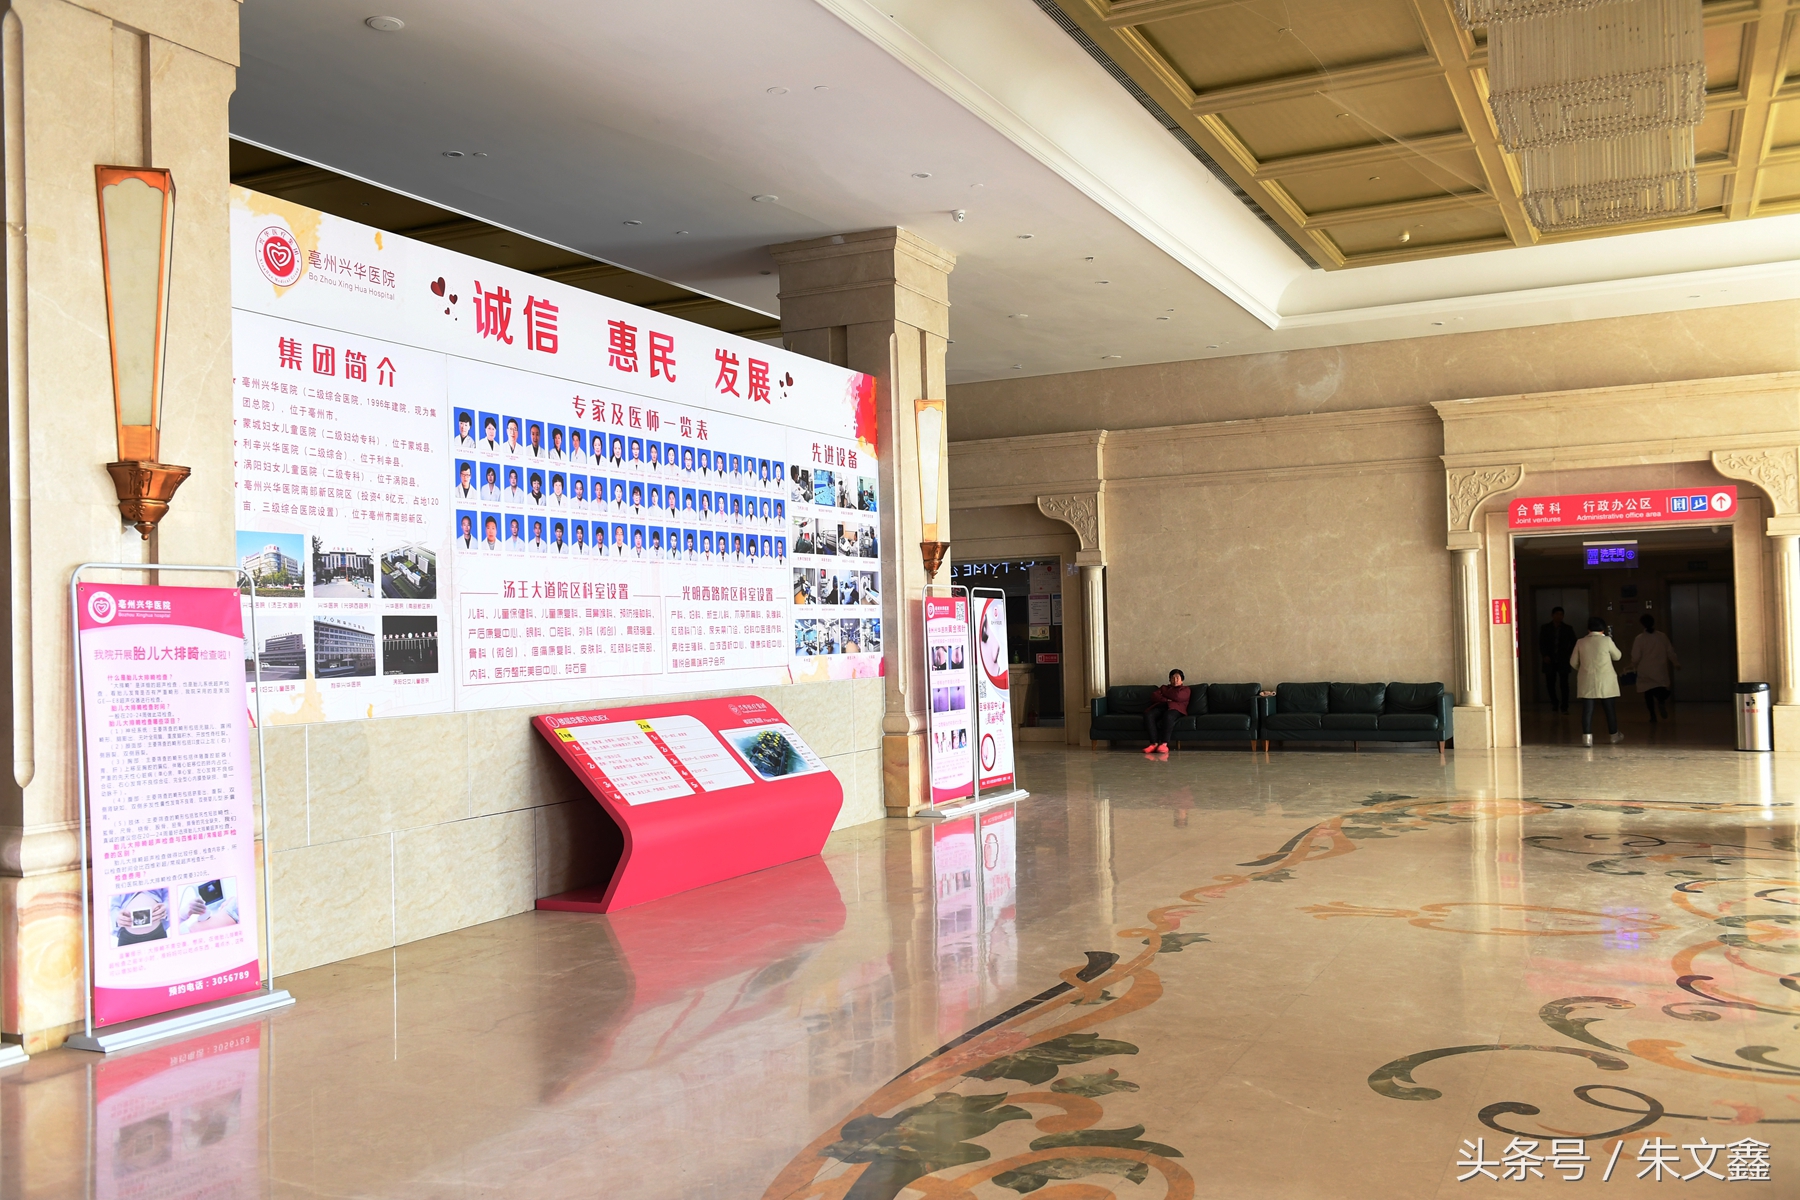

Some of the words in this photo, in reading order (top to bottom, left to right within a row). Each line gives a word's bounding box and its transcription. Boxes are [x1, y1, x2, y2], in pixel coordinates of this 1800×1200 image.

[308, 249, 396, 289] 亳州兴华医院
[308, 272, 318, 281] Bo
[319, 274, 337, 286] Zhou
[338, 278, 353, 292] Xing
[354, 282, 368, 294] Hua
[368, 286, 395, 301] Hospital
[473, 280, 559, 355] 诚信
[607, 318, 677, 383] 惠民
[714, 348, 771, 405] 发展
[278, 336, 397, 388] 集团简介
[572, 394, 708, 441] 专家及医师一览表
[812, 442, 857, 470] 先进设备
[1515, 517, 1530, 525] Joint
[1530, 516, 1561, 524] ventures
[1576, 513, 1624, 521] Administrative
[1625, 511, 1642, 519] office
[1517, 503, 1562, 517] 合管科
[1583, 497, 1653, 513] 行政办公区
[1600, 548, 1625, 557] 洗手间
[503, 580, 629, 600] 汤王大道院区科室设置
[682, 585, 774, 602] 光明西路院区科室设置
[118, 599, 171, 610] 亳州兴华医院
[168, 970, 250, 997] 预约电话：3056789
